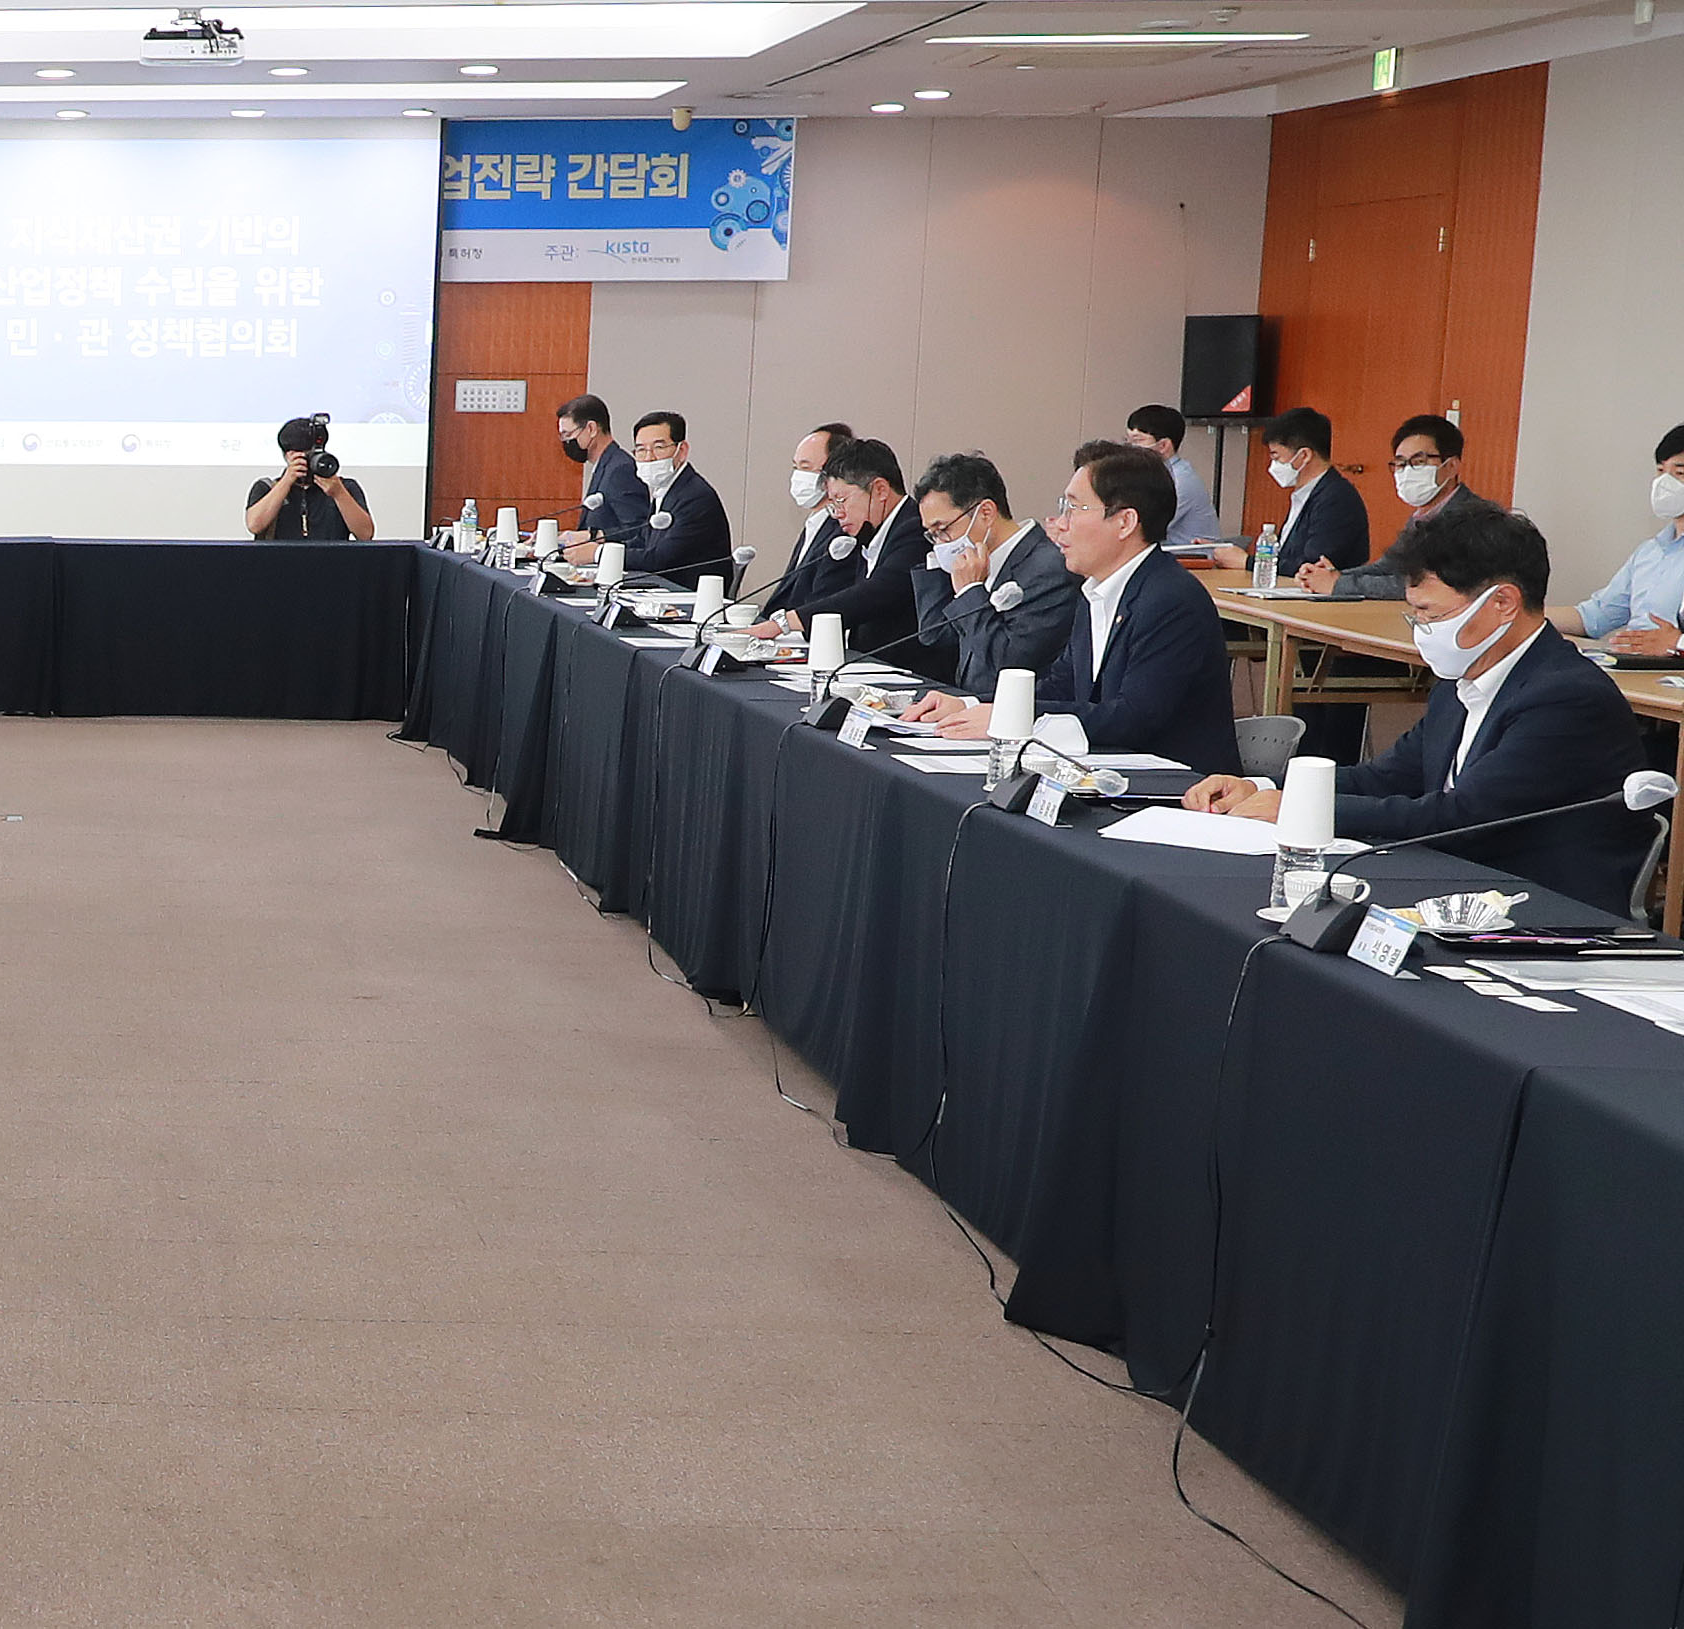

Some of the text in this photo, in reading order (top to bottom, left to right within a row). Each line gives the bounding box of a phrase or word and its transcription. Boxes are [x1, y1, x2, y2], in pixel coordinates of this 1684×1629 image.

[443, 153, 689, 200] 업전략 간담회
[196, 215, 299, 256] 기반의
[545, 245, 579, 263] 주관:
[606, 240, 649, 254] kista
[134, 266, 241, 307] 수립을
[253, 266, 325, 307] 위한
[7, 318, 38, 357] 민
[77, 317, 113, 357] 관
[125, 317, 299, 358] 정책협의회
